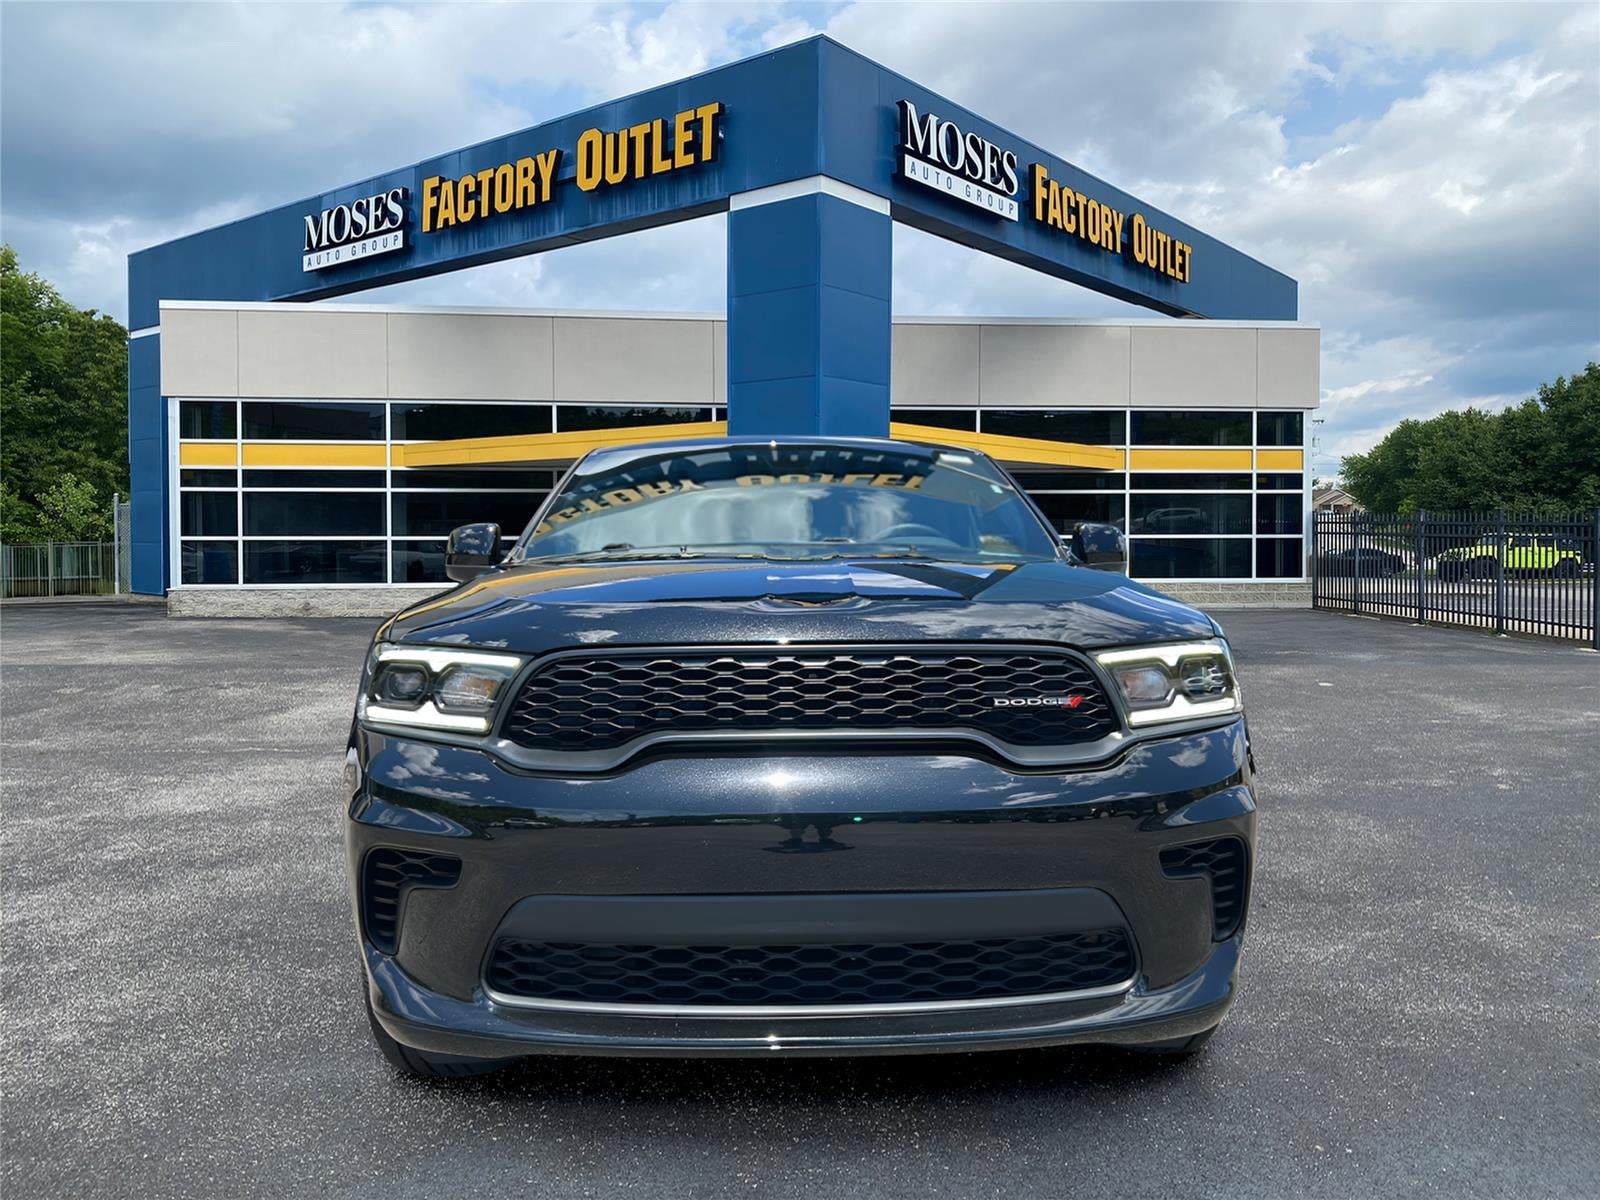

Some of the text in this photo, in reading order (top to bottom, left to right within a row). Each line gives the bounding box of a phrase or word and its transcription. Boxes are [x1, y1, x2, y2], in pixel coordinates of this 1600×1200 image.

[422, 102, 721, 233] FACTORY OUTLET
[904, 99, 1019, 197] MOSES
[303, 187, 404, 251] MOSES
[910, 160, 1014, 215] AUTO GROUP
[307, 235, 399, 268] AUTO GROUP
[1034, 163, 1192, 283] FACTORY OUTLET
[993, 696, 1071, 707] DODGE
